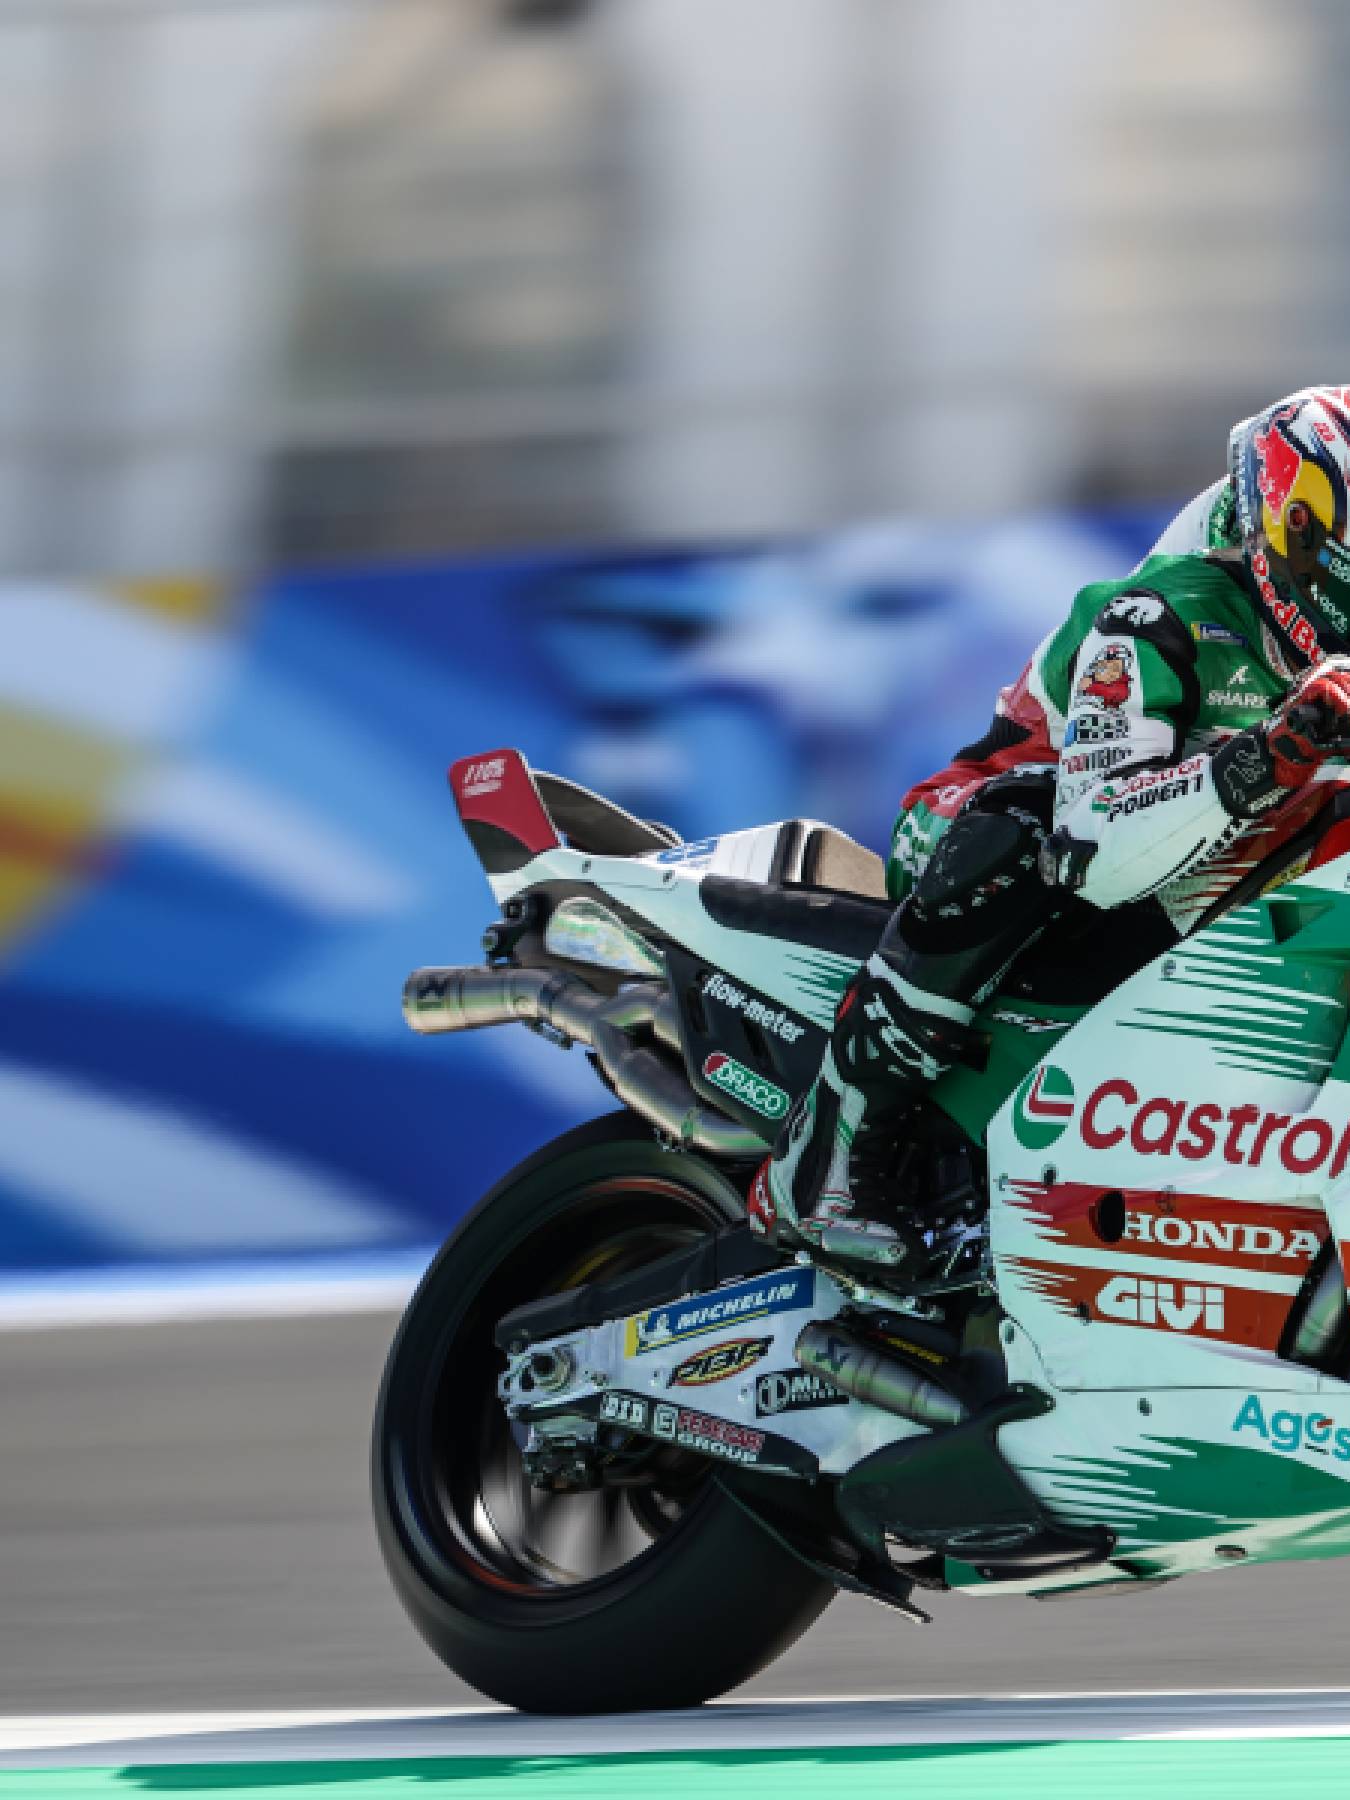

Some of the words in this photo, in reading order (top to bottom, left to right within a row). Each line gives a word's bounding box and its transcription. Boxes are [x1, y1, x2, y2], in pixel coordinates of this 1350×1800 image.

[1204, 688, 1270, 710] SHARK
[702, 973, 805, 1044] flow-meter
[716, 1062, 783, 1112] DRACO
[1122, 1212, 1322, 1260] HONDA
[676, 1281, 797, 1331] MICHELIN
[1096, 1275, 1225, 1332] GIVI
